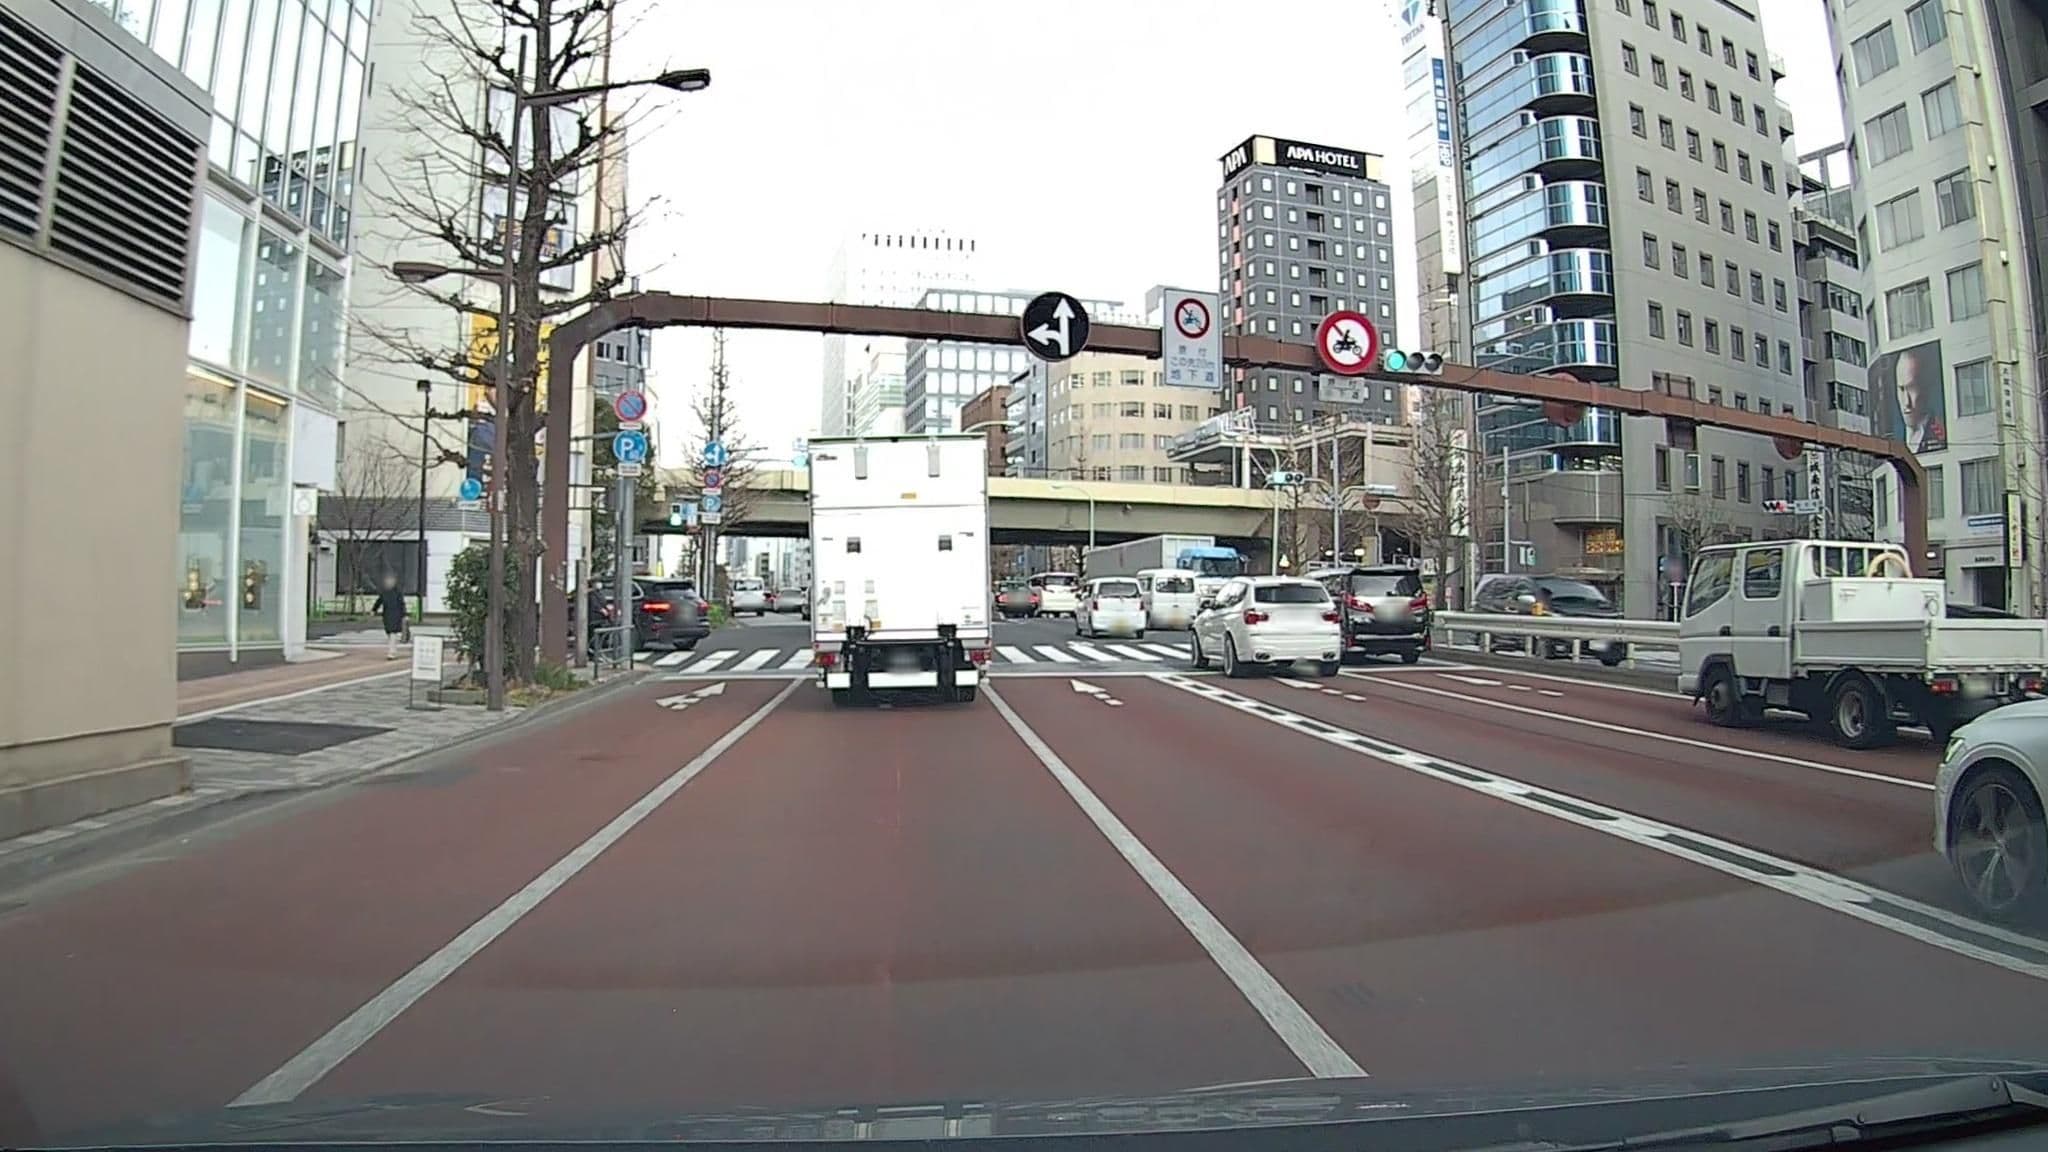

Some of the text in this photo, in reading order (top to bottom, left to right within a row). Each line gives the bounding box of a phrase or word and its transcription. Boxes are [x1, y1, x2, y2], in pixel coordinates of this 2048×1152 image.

[1224, 146, 1247, 176] APA
[1287, 145, 1359, 169] APA HOTEL
